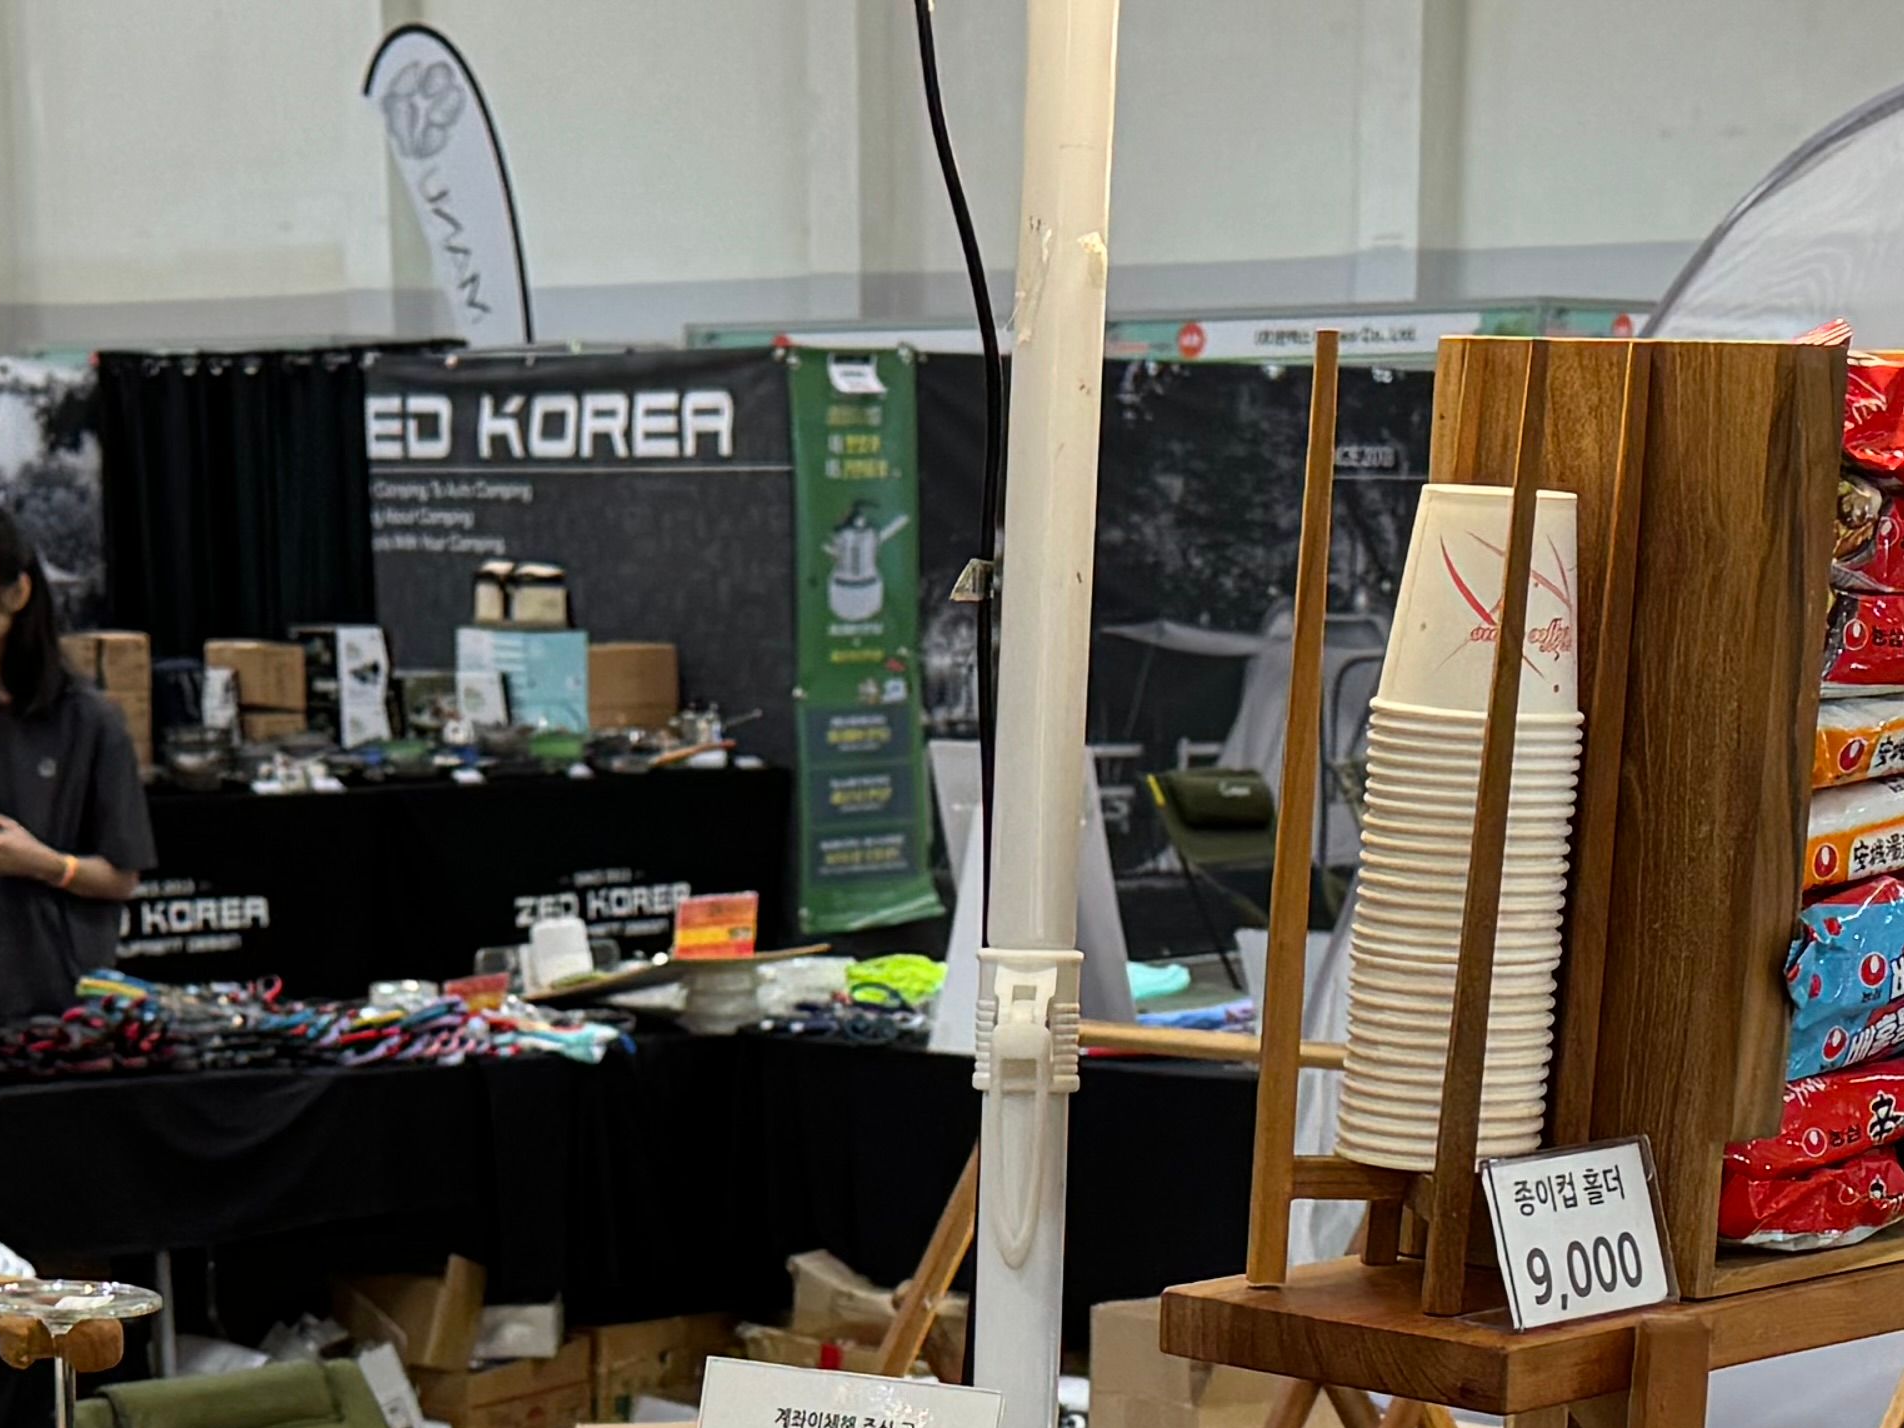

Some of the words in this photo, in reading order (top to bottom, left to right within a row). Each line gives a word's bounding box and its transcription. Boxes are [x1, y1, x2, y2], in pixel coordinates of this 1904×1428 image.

[478, 390, 735, 459] KOREA
[141, 895, 270, 936] KOREA
[1513, 1171, 1578, 1217] 종이컵
[1582, 1164, 1626, 1206] 홀더
[1525, 1231, 1643, 1311] 9,000
